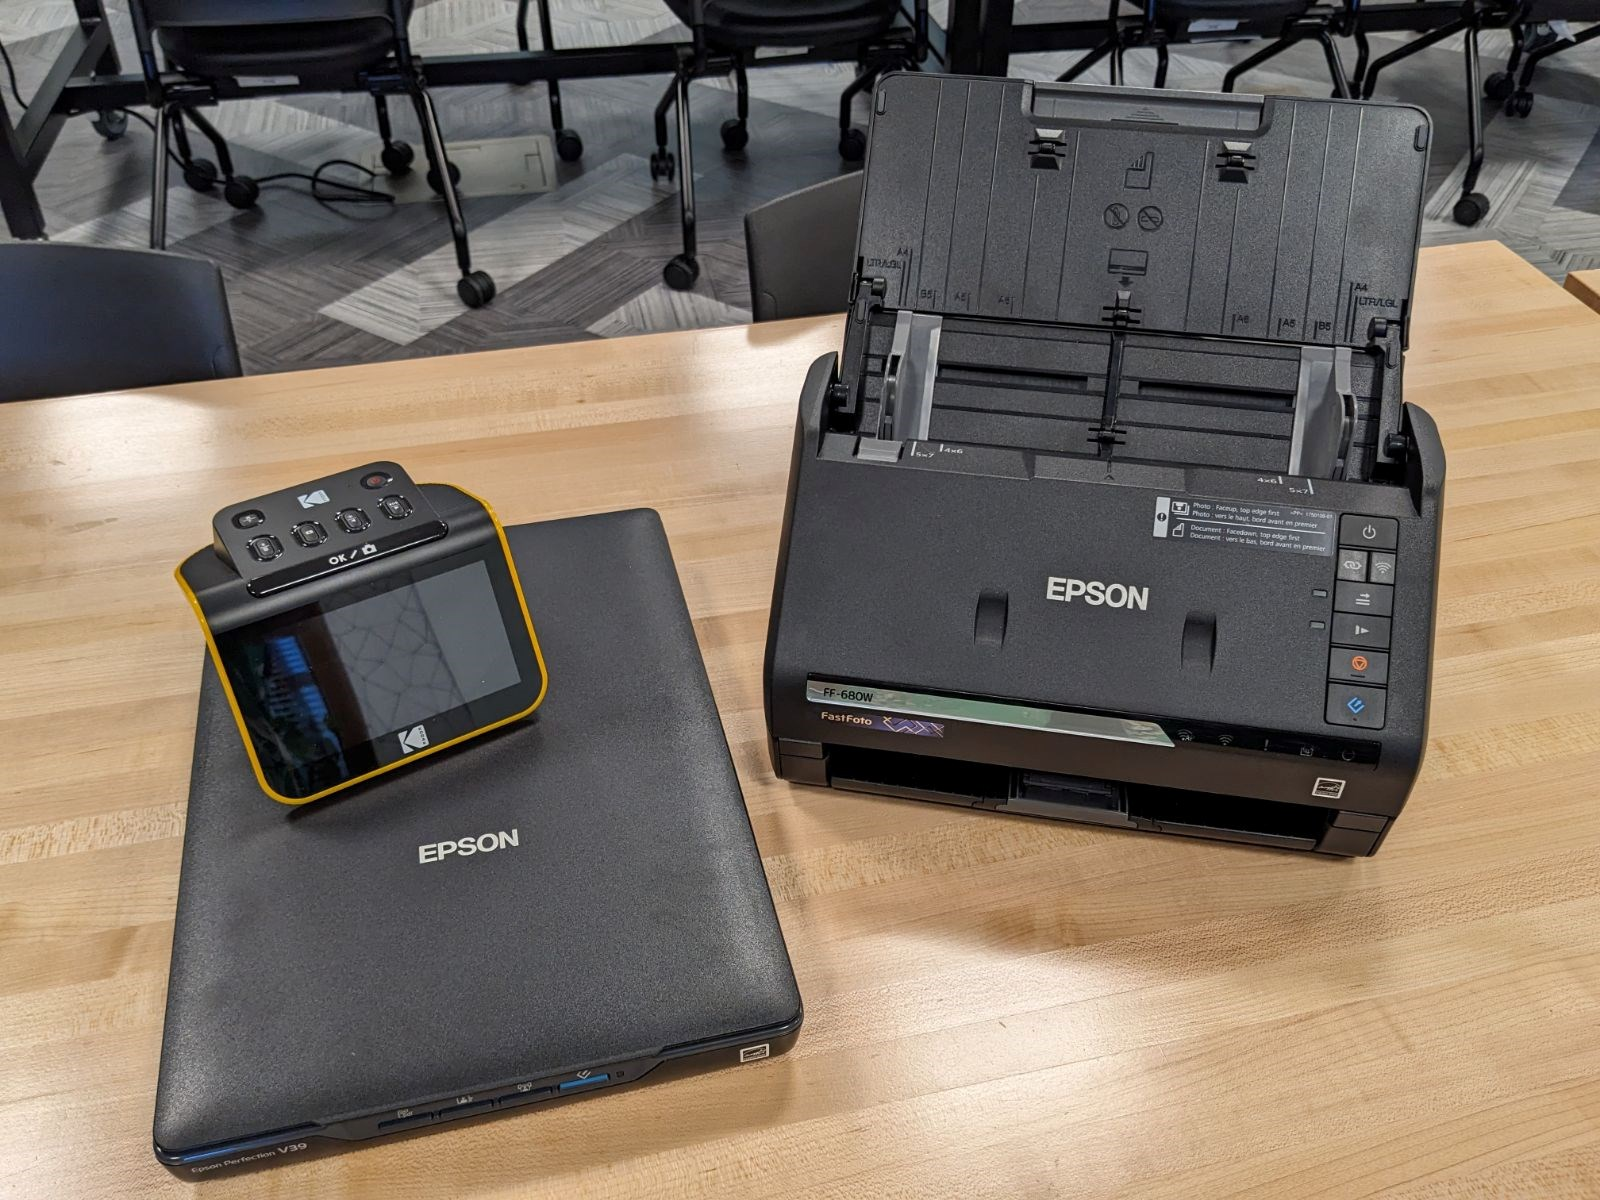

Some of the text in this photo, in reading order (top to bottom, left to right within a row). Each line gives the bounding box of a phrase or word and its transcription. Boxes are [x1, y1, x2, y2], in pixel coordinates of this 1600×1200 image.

[1354, 283, 1368, 292] A4
[1359, 296, 1398, 308] LTR/LGL
[1193, 502, 1211, 510] Photo
[1240, 507, 1251, 515] top
[1251, 508, 1267, 517] edge
[1267, 509, 1280, 517] first
[1192, 510, 1210, 518] Photo
[1251, 516, 1267, 524] bord
[1267, 518, 1284, 526] avant
[1294, 521, 1319, 529] premier
[1190, 524, 1222, 534] Document
[1260, 532, 1271, 540] top
[1271, 533, 1287, 541] edge
[1189, 532, 1221, 542] Document
[1275, 541, 1291, 549] avant
[1302, 544, 1326, 552] premier
[329, 554, 347, 565] OK
[1046, 576, 1149, 611] EPSON
[823, 687, 874, 703] FF-680W
[821, 711, 873, 726] FastFoto
[418, 828, 519, 864] EPSON
[192, 1143, 307, 1173] Epson Perfection V39
